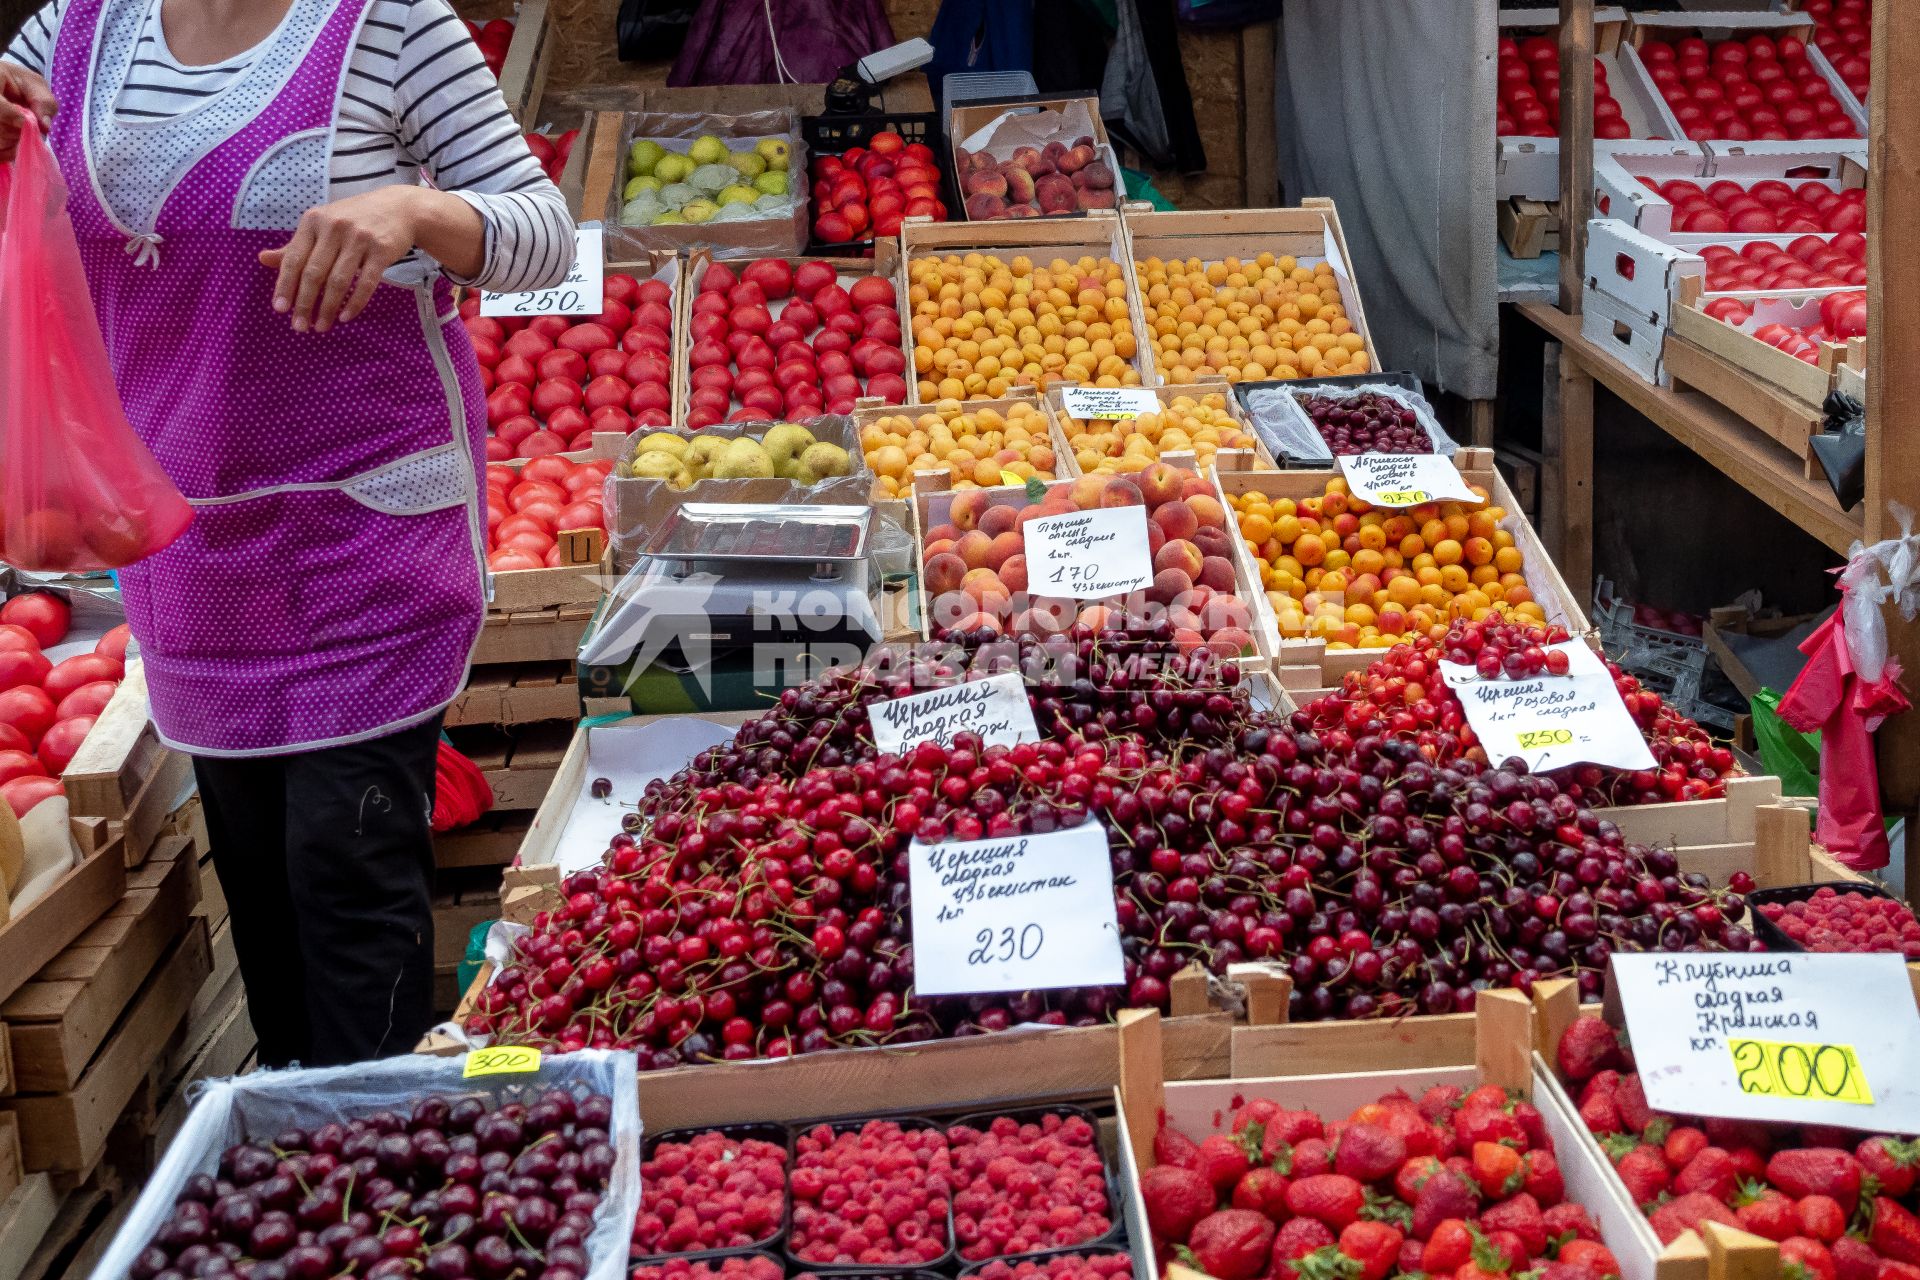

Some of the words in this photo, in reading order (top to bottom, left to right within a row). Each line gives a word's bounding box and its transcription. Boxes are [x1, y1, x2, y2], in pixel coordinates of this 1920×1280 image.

[1350, 456, 1414, 469] Абрикосы
[1037, 517, 1093, 533] Персики
[1065, 532, 1116, 549] сладкие
[1049, 563, 1099, 583] 170
[883, 681, 998, 727] Черешня
[1475, 681, 1543, 704] Черешня
[903, 702, 986, 745] сладкая
[1536, 702, 1596, 719] сладкая
[1522, 729, 1573, 748] 250
[928, 839, 1028, 874] Черешня
[941, 861, 1015, 888] сладкая
[968, 923, 1044, 965] 230
[1655, 959, 1793, 993] Клубника
[1695, 986, 1784, 1014] сладкая
[1696, 1010, 1819, 1036] Крымская
[468, 1053, 531, 1072] 300
[1734, 1041, 1849, 1096] 200
